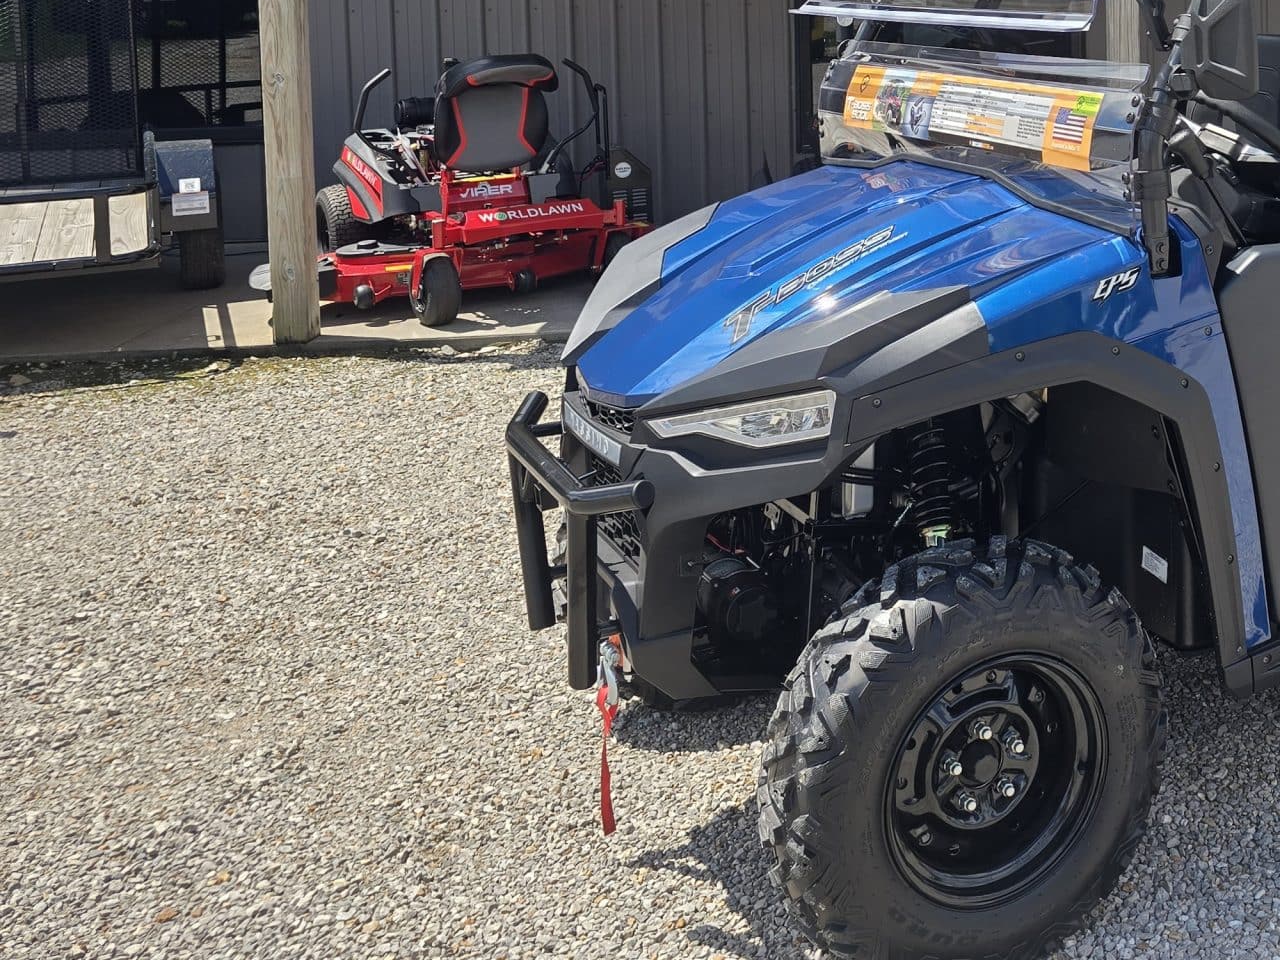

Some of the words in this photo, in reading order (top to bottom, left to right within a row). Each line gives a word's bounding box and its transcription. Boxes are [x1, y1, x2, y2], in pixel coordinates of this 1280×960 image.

[460, 182, 513, 199] VIPER
[479, 203, 584, 222] WORLDLAWN
[1092, 267, 1141, 301] EPS
